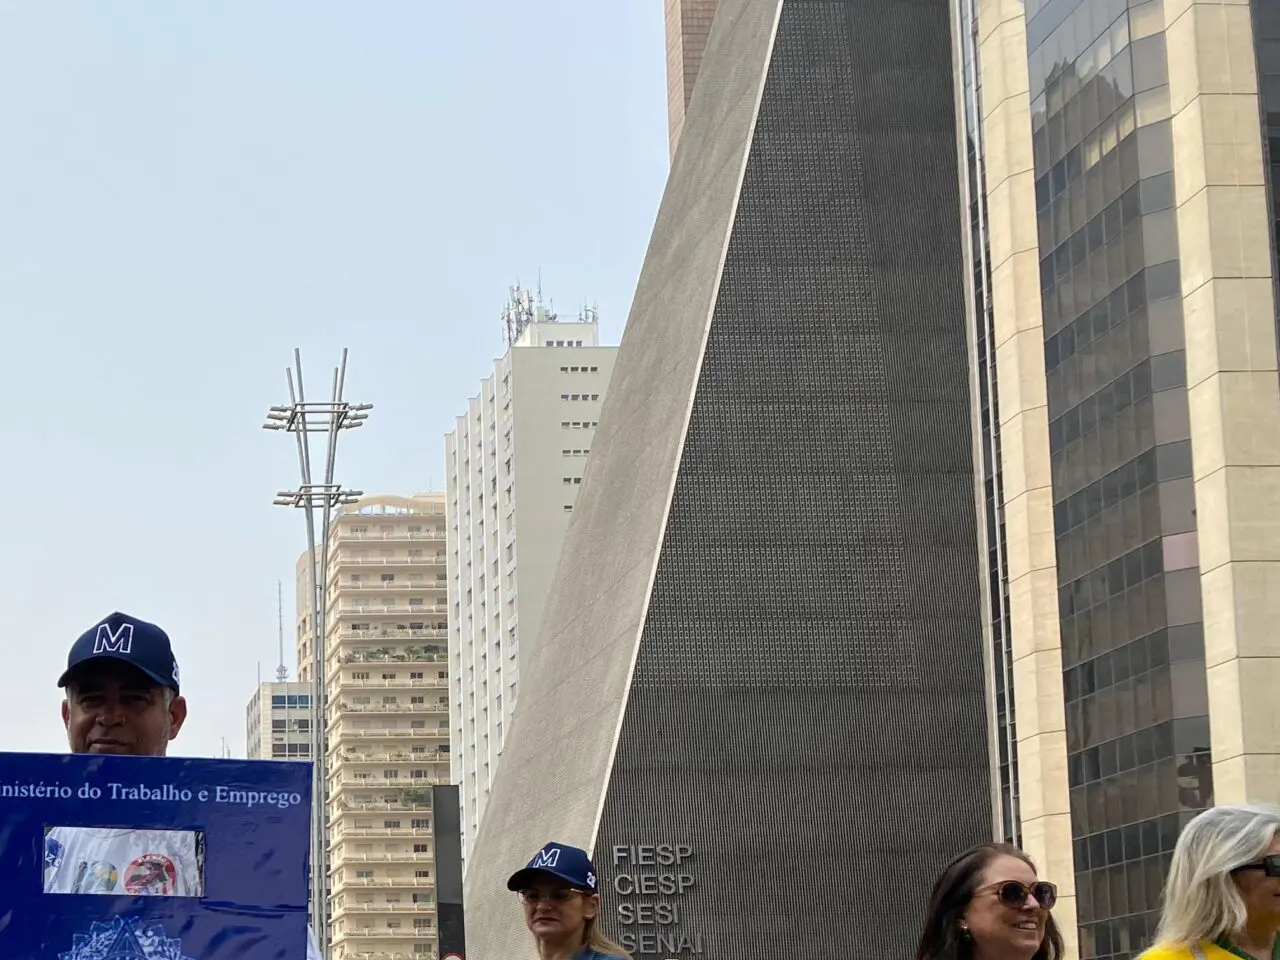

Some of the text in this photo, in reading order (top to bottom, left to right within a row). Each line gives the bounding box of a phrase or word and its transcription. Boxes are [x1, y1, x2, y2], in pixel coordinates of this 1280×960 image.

[93, 623, 134, 653] M
[77, 782, 101, 799] do
[107, 783, 192, 801] Trabalho
[198, 789, 209, 802] e
[215, 786, 301, 808] Emprego
[533, 848, 561, 868] M
[613, 845, 693, 865] FIESP
[614, 874, 696, 895] CIESP
[618, 903, 679, 925] SESI
[620, 933, 704, 954] SENAI
